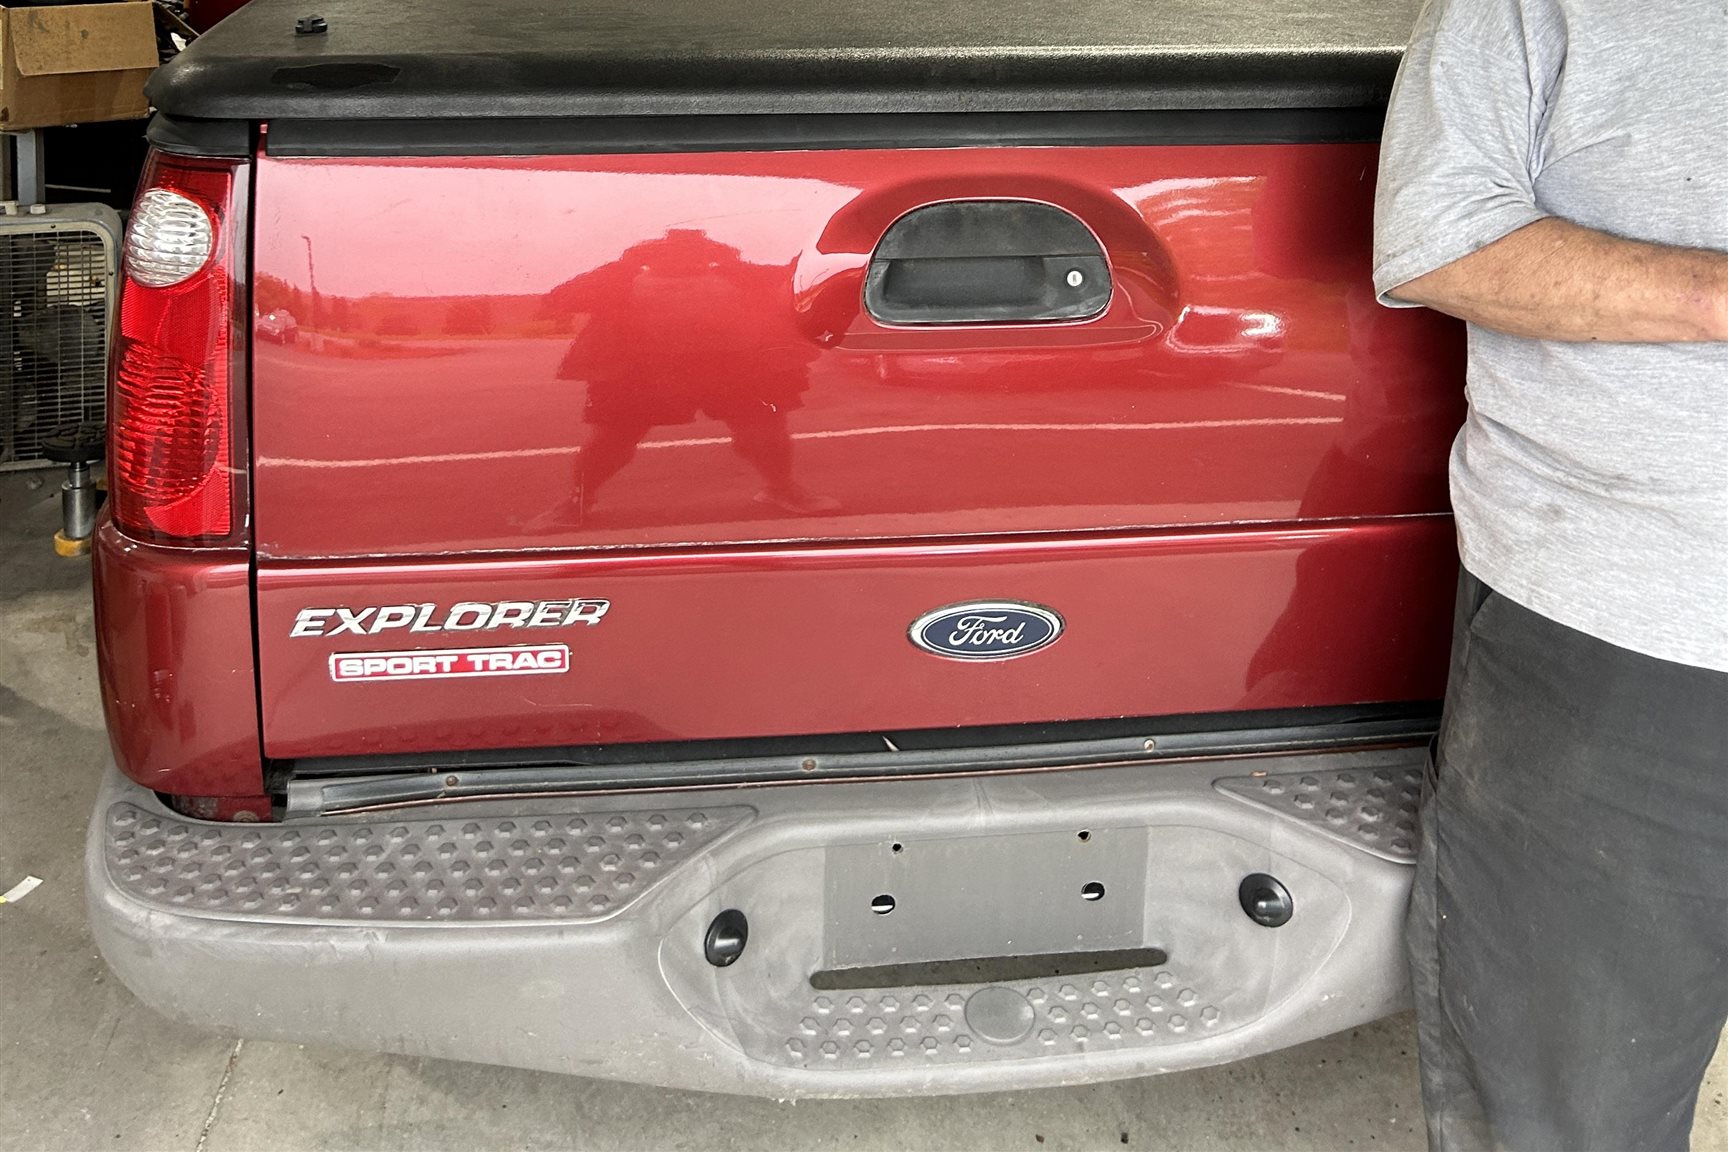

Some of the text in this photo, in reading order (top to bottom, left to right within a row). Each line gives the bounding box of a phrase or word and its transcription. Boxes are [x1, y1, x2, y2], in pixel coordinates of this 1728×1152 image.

[289, 598, 610, 638] EXPLORER
[949, 615, 1026, 646] Ford
[339, 650, 562, 677] SPORT TRAC
